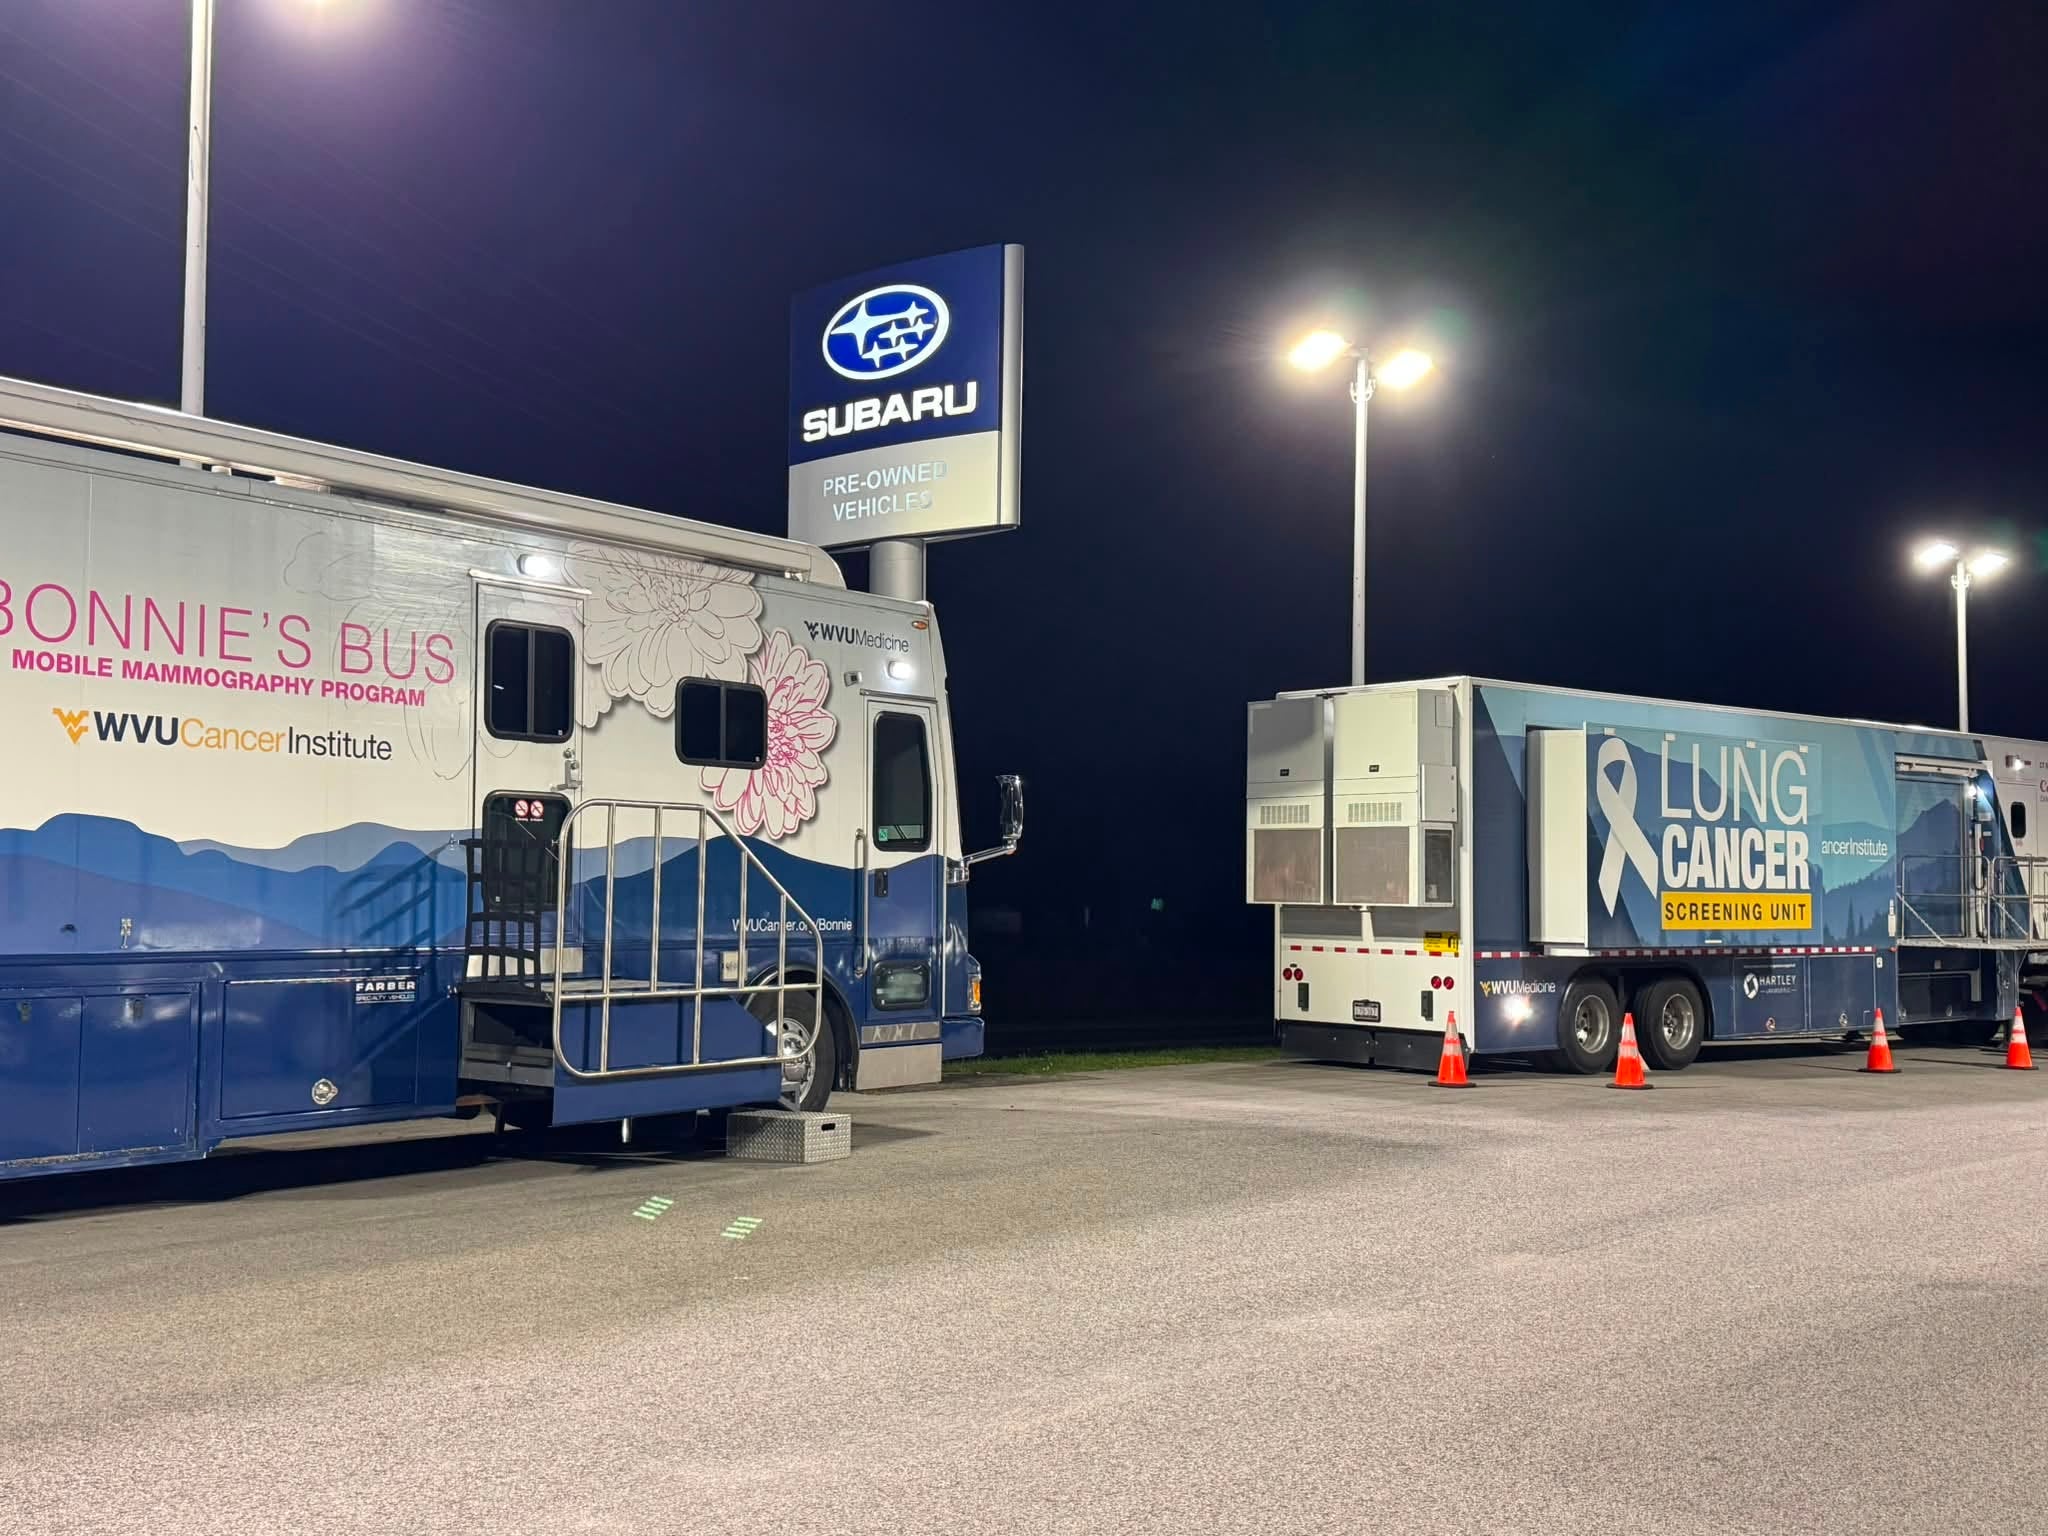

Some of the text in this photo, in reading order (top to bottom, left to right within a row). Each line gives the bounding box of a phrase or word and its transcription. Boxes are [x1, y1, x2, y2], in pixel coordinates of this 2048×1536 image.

[803, 381, 977, 442] SUBARU
[823, 461, 947, 497] PRE-OWNED
[832, 491, 933, 521] VEHICLES
[340, 622, 455, 684] BUS
[12, 649, 425, 707] MOBILE MAMMOGRAPHY PROGRAM
[1661, 740, 1808, 825] LUNG
[1662, 824, 1810, 889] CANCER
[1665, 902, 1806, 921] SCREENING UNIT
[355, 981, 416, 992] FARBER
[1760, 975, 1796, 985] HARTLEY
